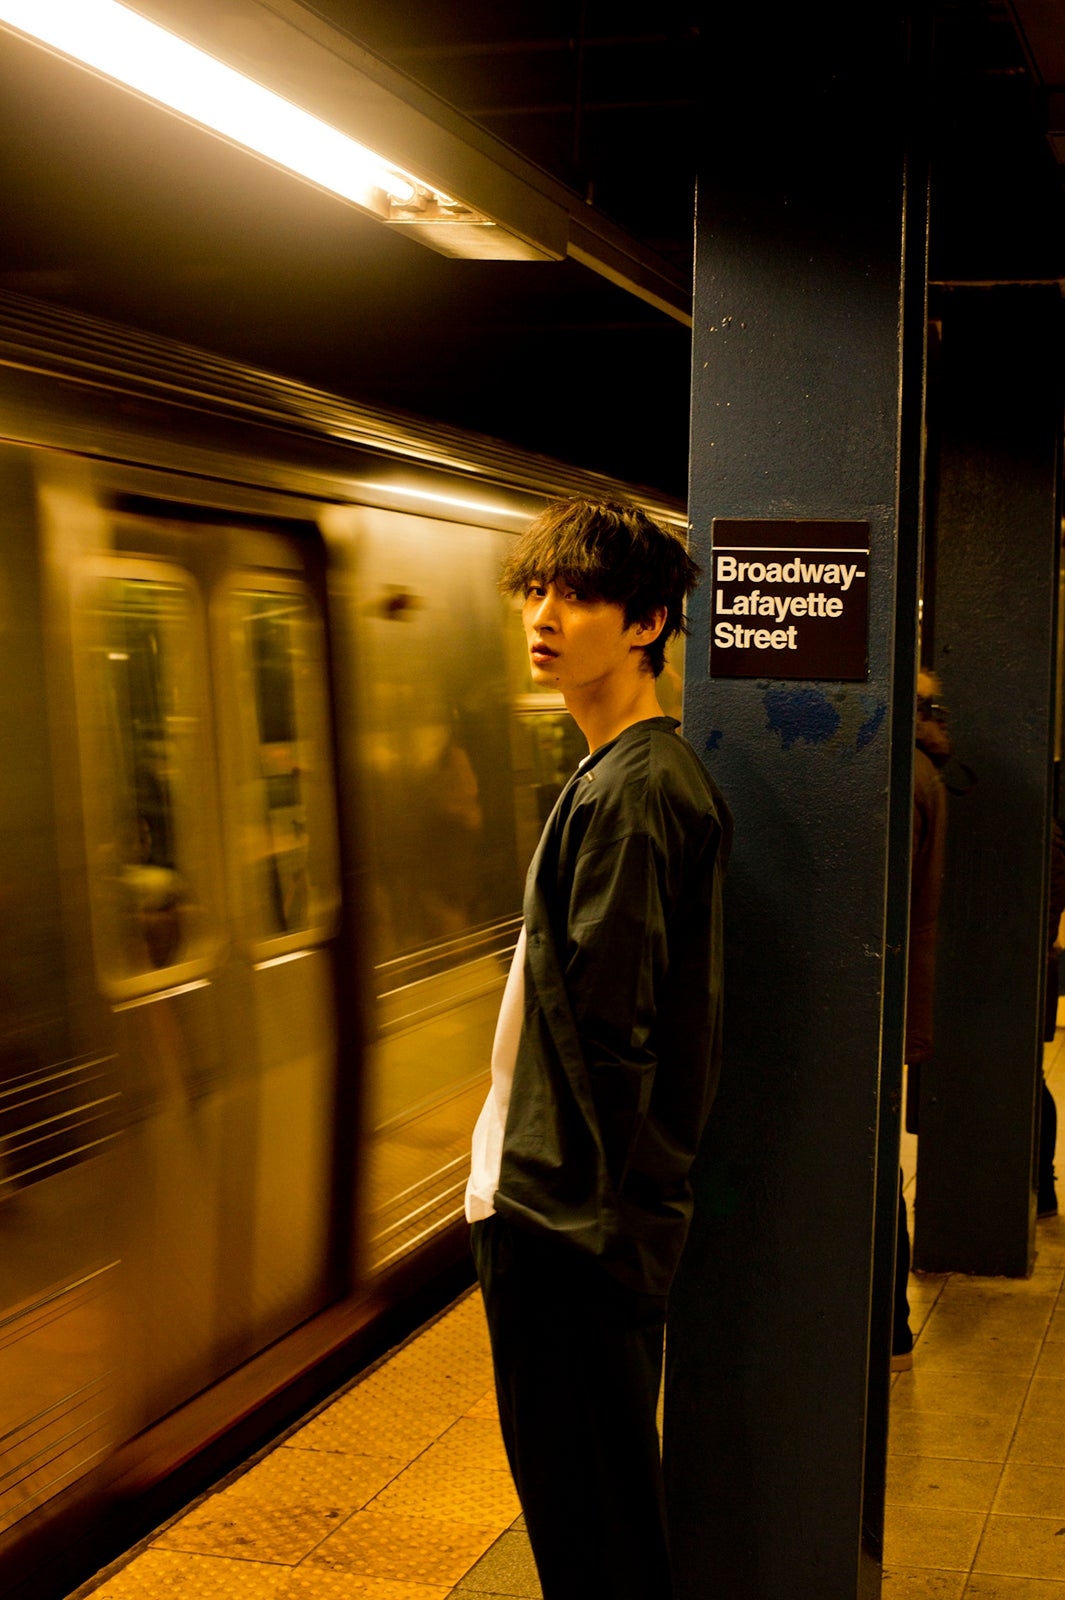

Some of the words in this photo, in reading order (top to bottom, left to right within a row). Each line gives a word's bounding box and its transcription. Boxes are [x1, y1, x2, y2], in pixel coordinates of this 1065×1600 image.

[716, 555, 866, 591] Broadway-
[715, 589, 844, 623] Lafayette
[714, 621, 798, 650] Street
